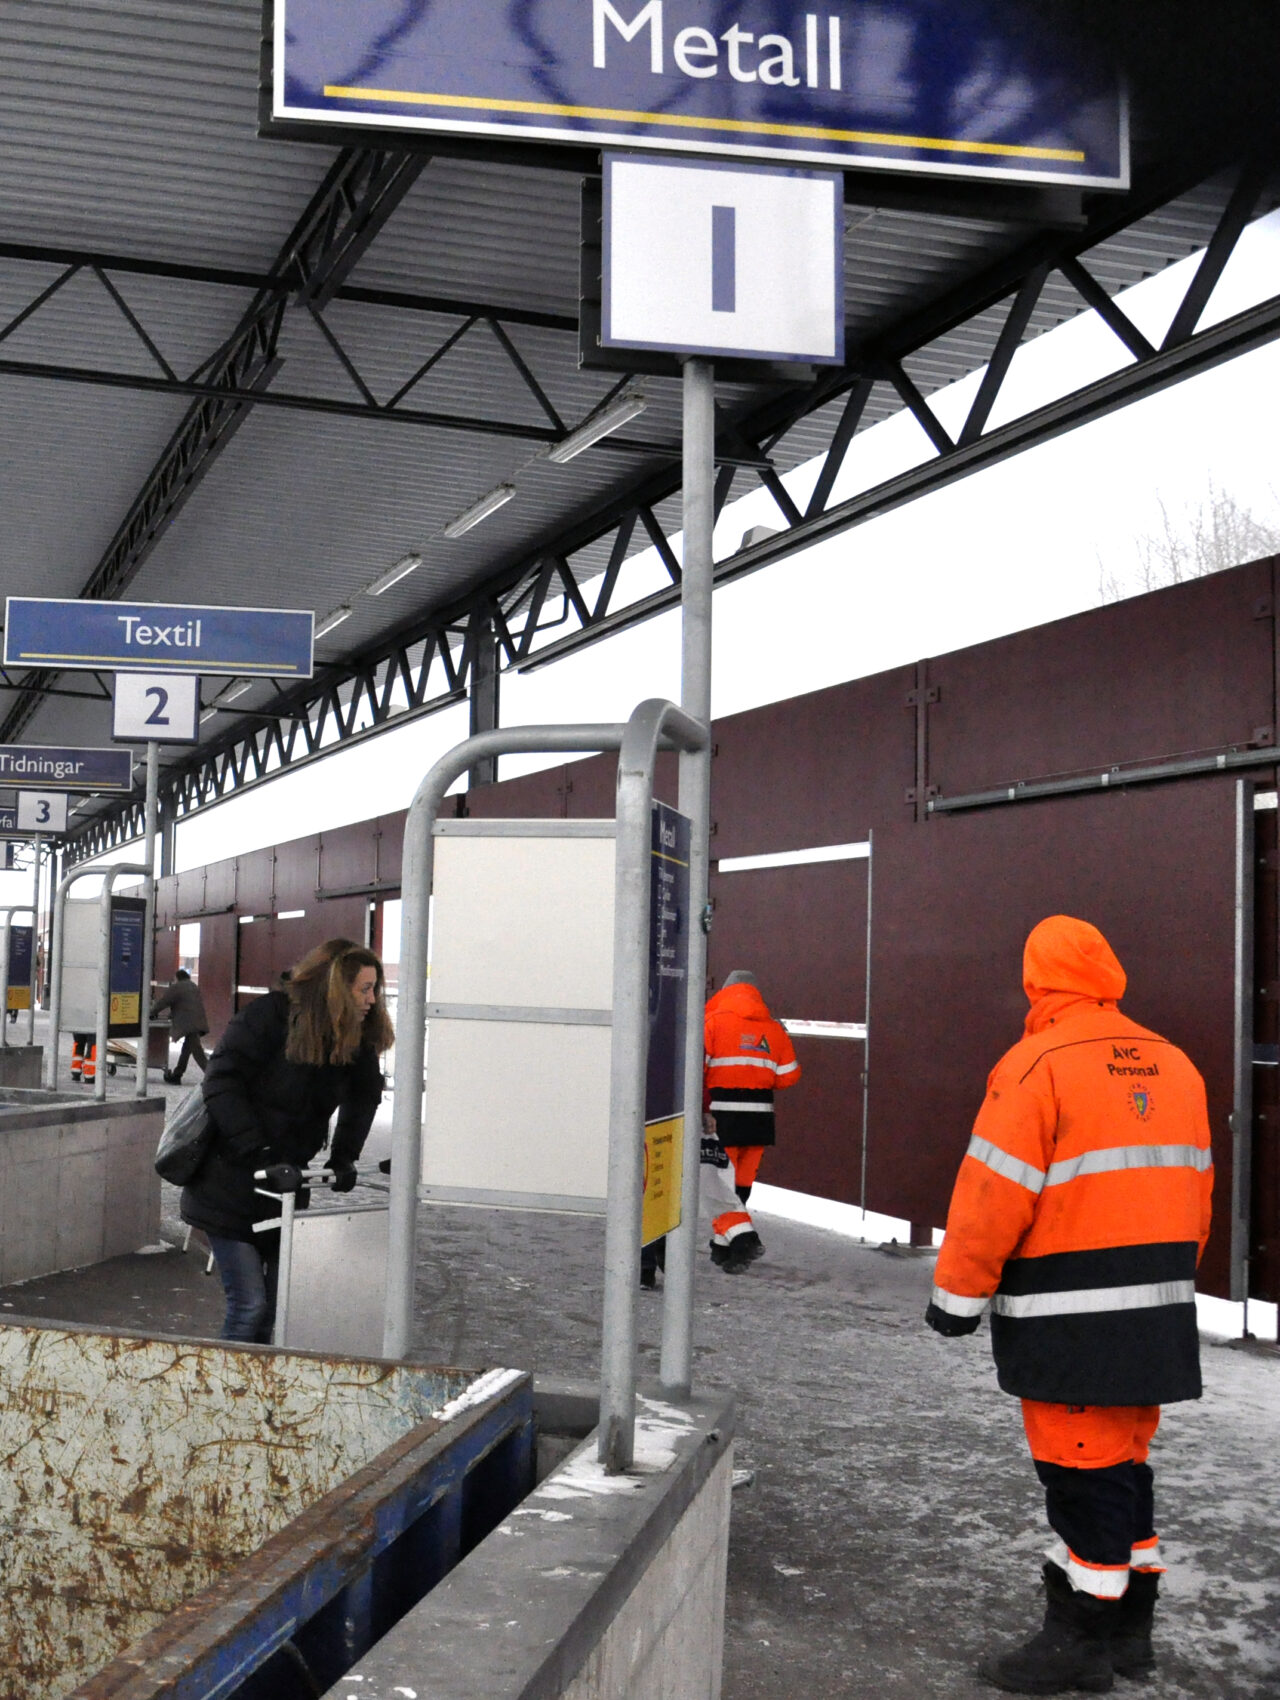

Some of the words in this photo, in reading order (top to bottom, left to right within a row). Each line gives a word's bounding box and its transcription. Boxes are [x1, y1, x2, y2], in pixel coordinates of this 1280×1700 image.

[592, 0, 843, 91] Metall
[118, 615, 201, 648] Textil
[144, 687, 170, 725] 2
[35, 799, 51, 823] 3
[1107, 1063, 1159, 1076] Personal
